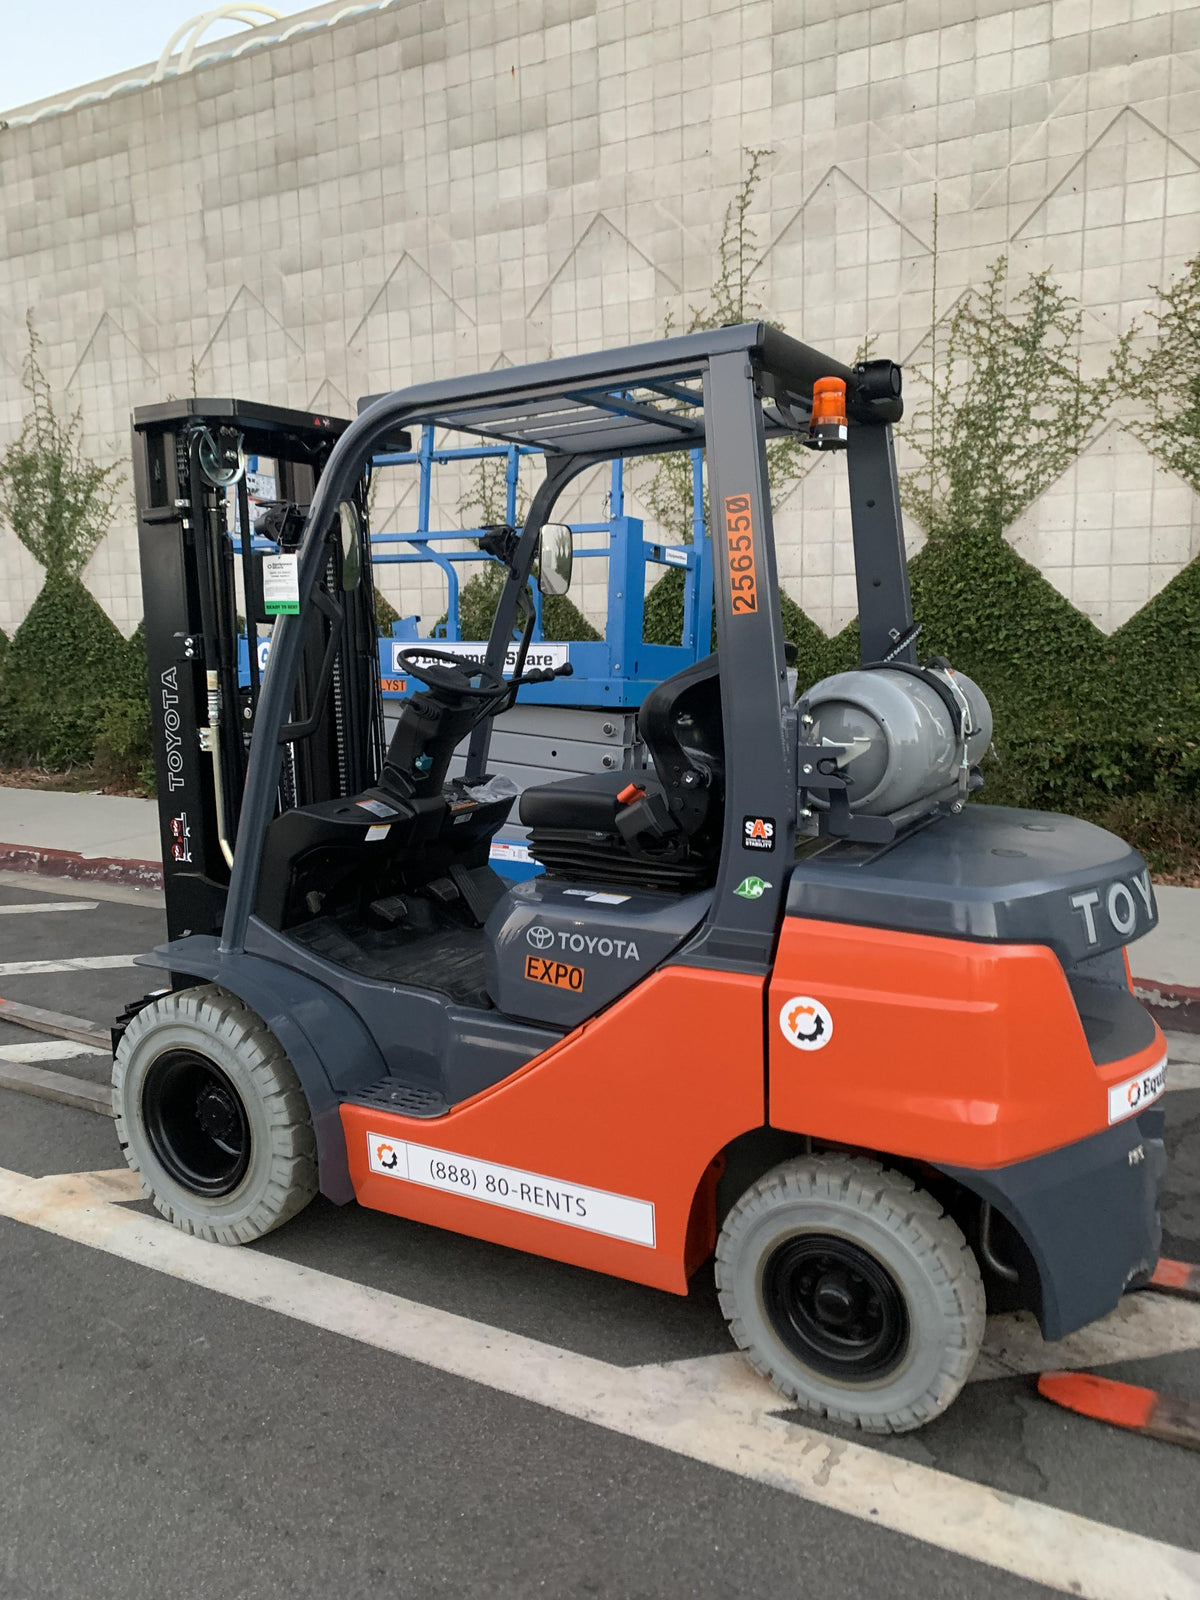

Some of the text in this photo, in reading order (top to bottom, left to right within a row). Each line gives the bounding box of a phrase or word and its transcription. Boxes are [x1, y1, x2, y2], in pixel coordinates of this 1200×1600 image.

[161, 666, 185, 791] TOYOTA
[745, 819, 774, 838] SAS
[1071, 867, 1153, 944] TOY
[558, 932, 640, 960] TOYOTA
[526, 957, 583, 989] EXPO
[429, 1159, 587, 1217] (888) 80-RENTS
